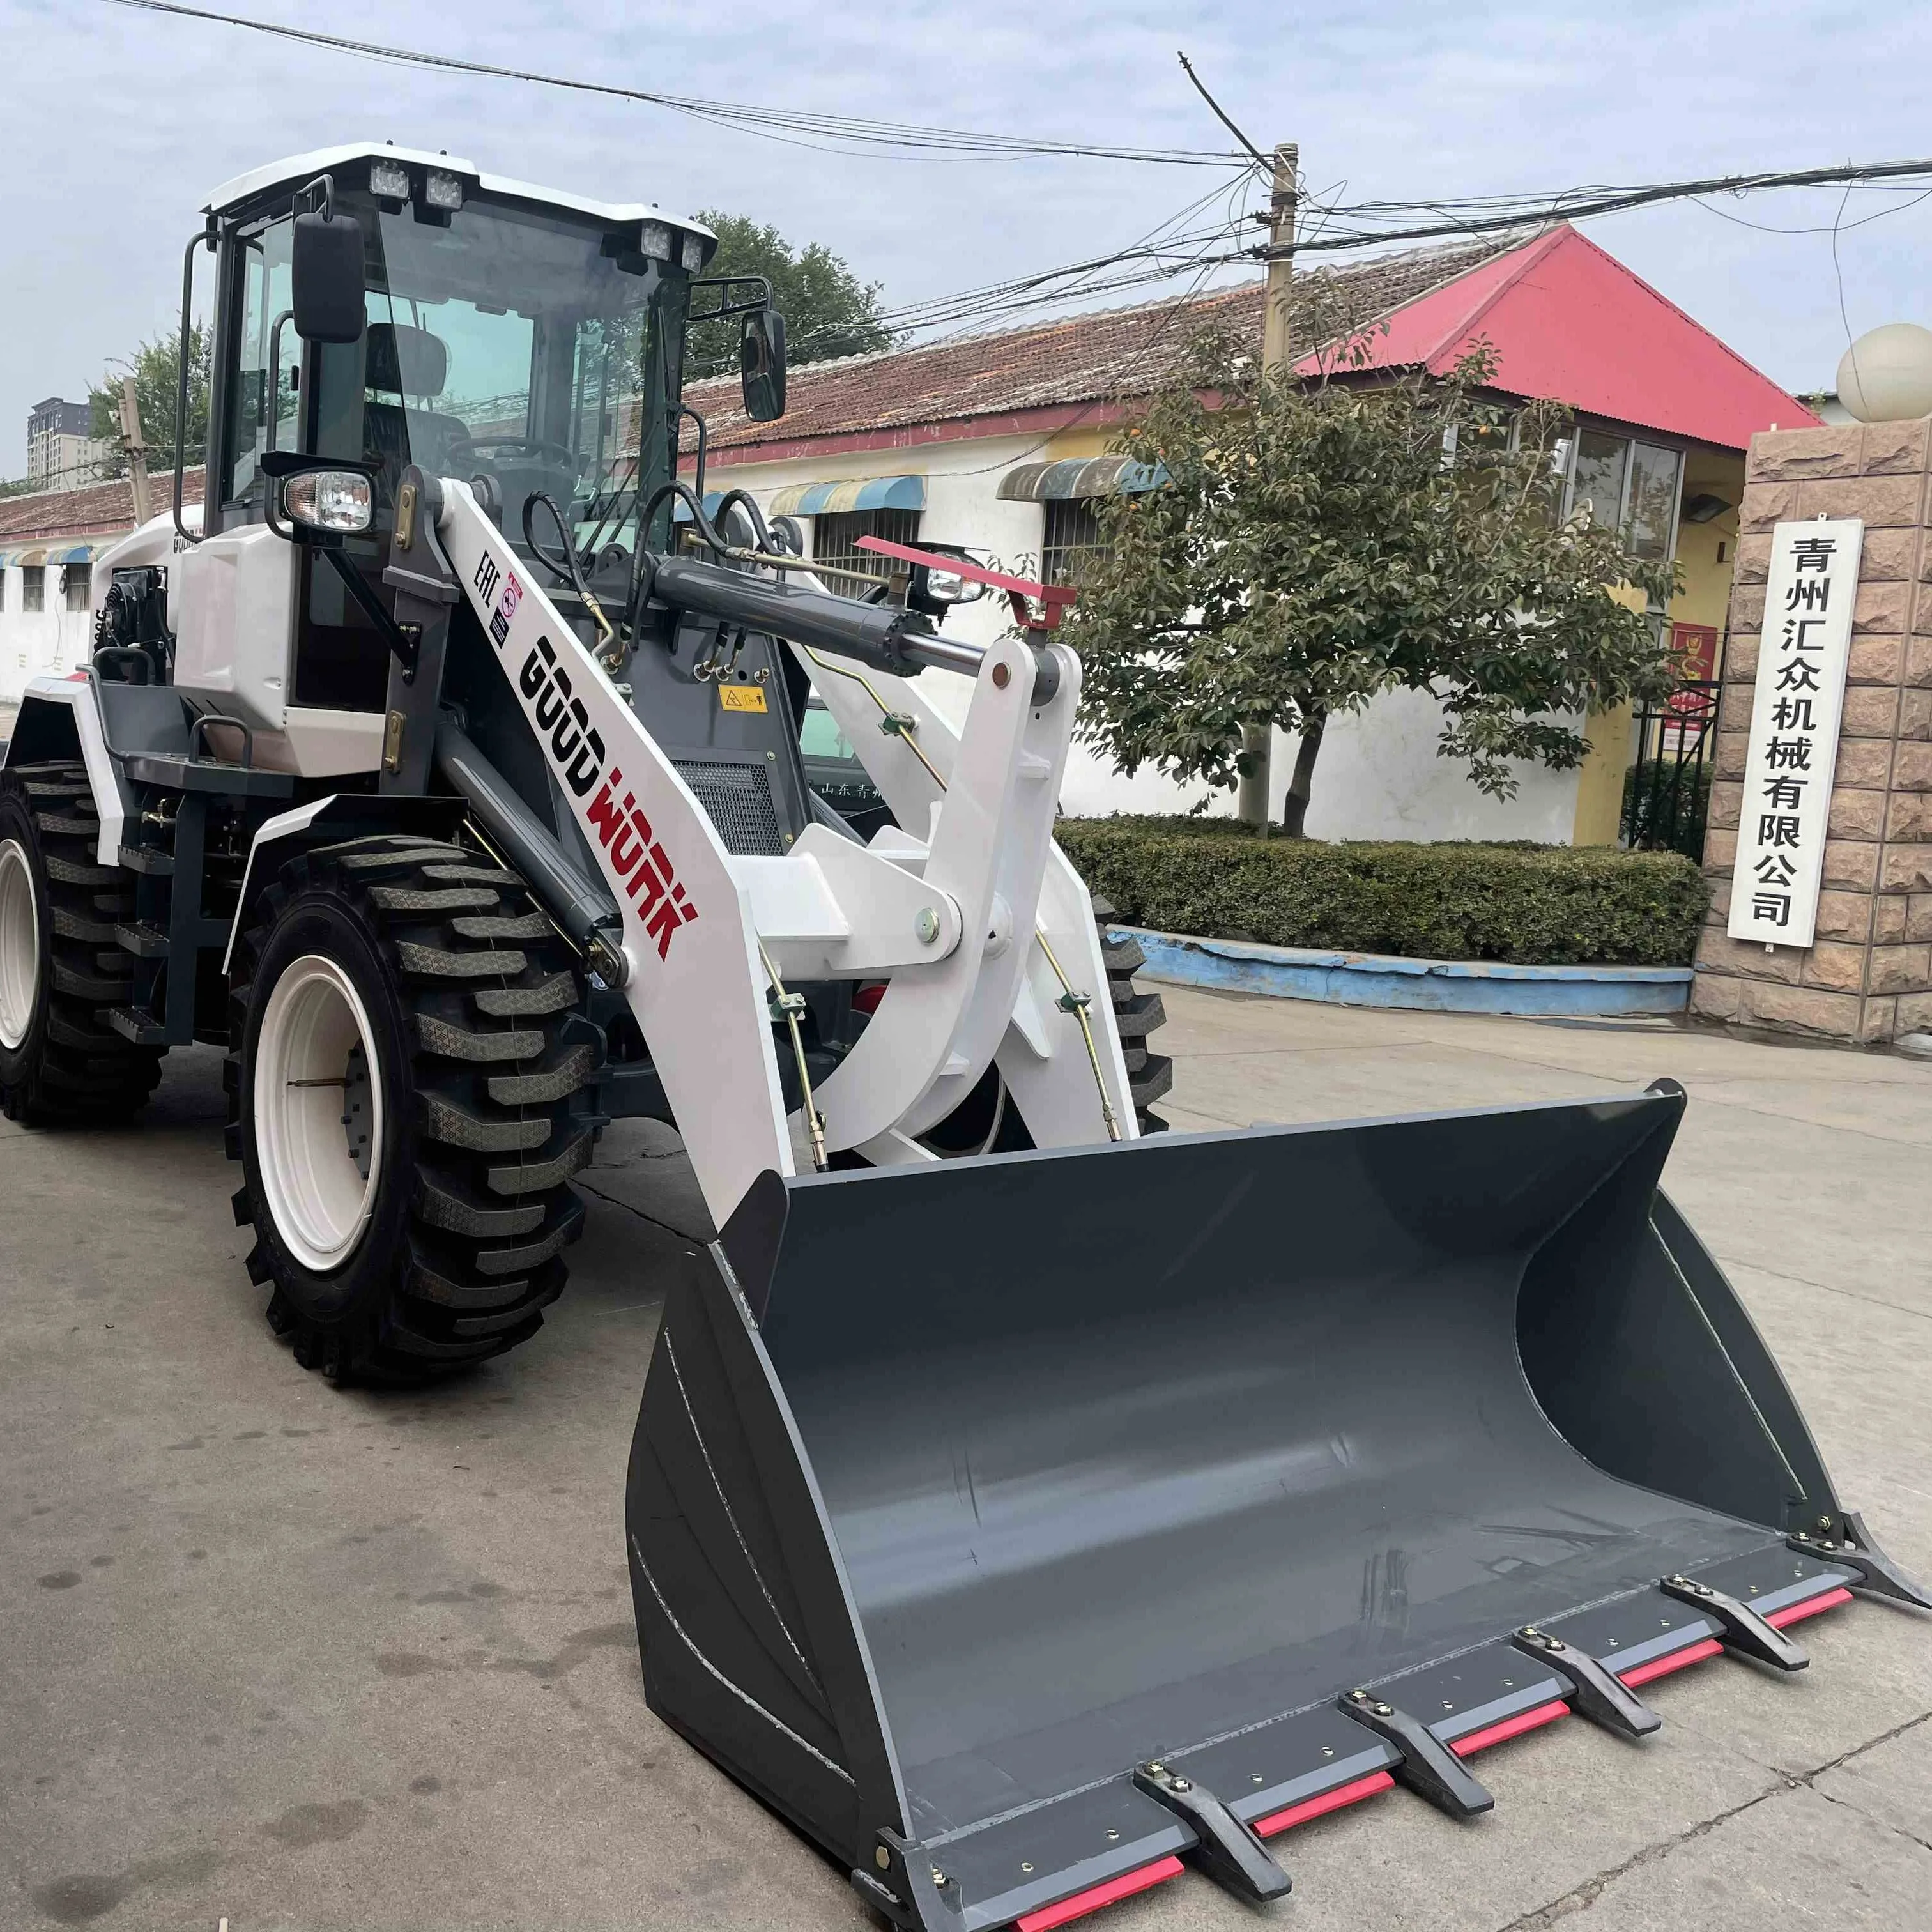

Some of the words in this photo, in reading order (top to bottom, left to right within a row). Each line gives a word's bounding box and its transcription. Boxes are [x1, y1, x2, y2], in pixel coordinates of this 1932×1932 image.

[1751, 537, 1837, 927] 青州汇众机械有限公司
